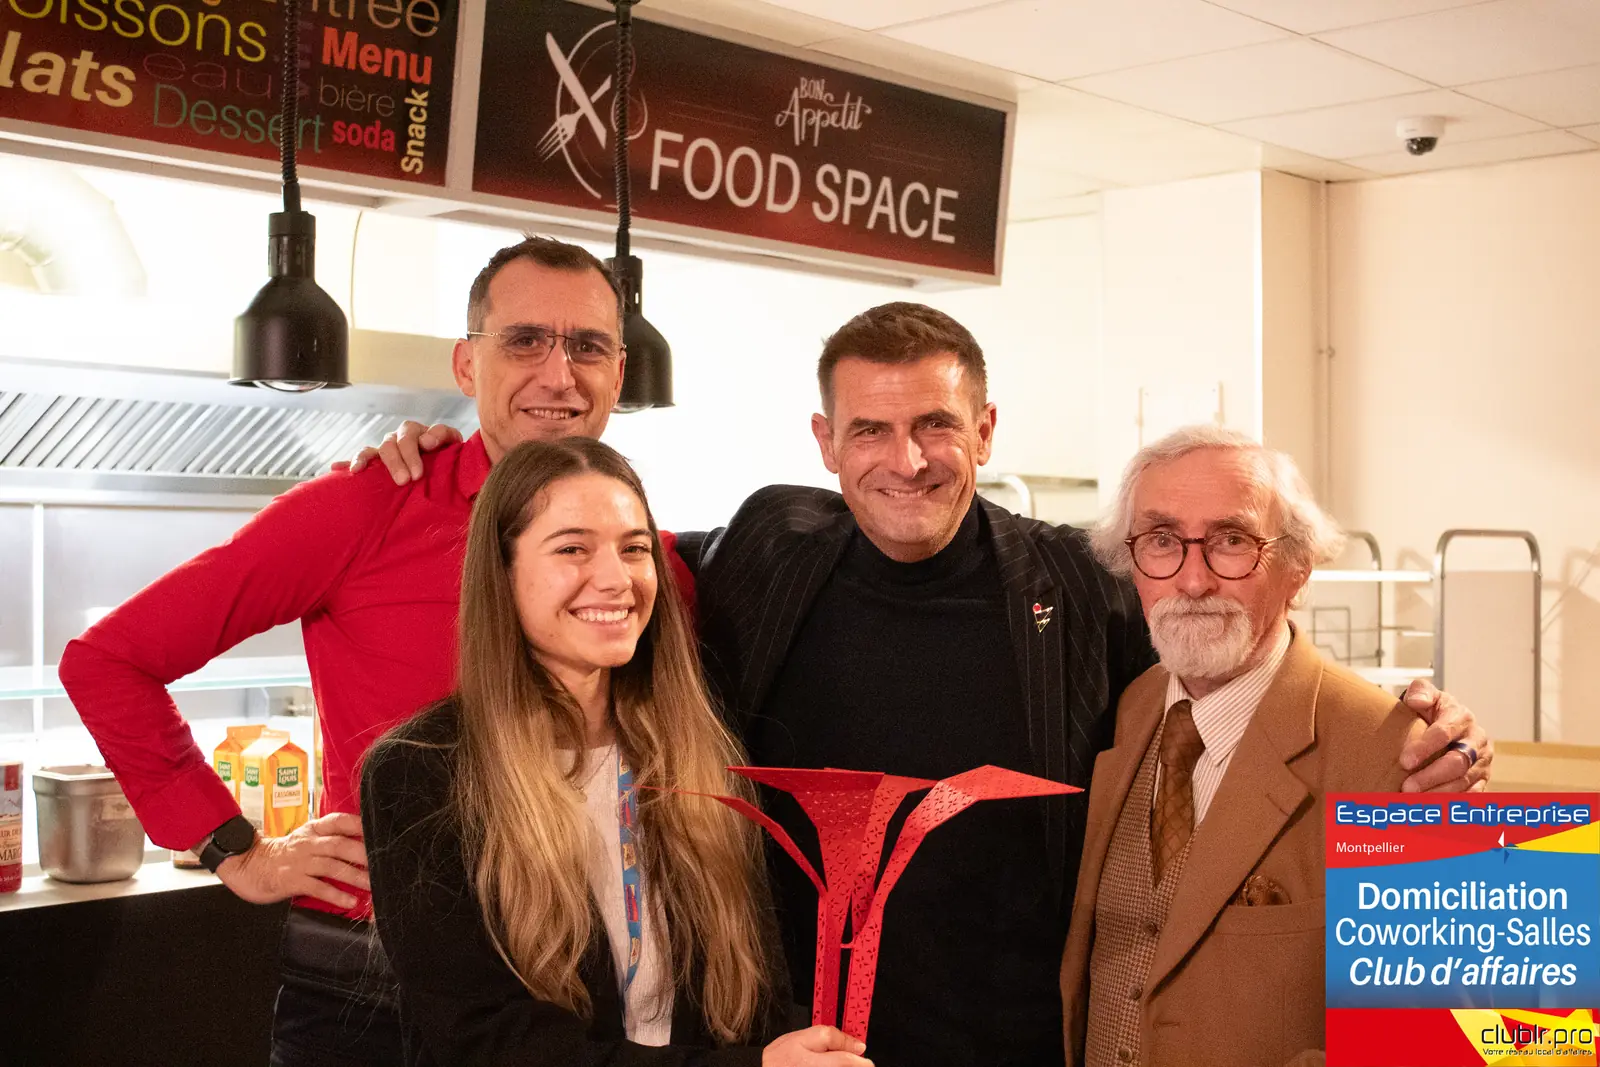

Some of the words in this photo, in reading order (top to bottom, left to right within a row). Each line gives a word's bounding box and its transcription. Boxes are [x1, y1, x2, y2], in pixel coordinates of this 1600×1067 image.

[143, 53, 272, 99] eau
[321, 26, 433, 85] Menu
[318, 76, 396, 117] bière
[775, 87, 872, 147] Appetit
[800, 76, 825, 100] BON
[153, 83, 325, 154] Dessert
[333, 120, 395, 152] soda
[401, 88, 429, 175] Snack
[650, 129, 801, 213] FOOD
[812, 163, 960, 243] SPACE
